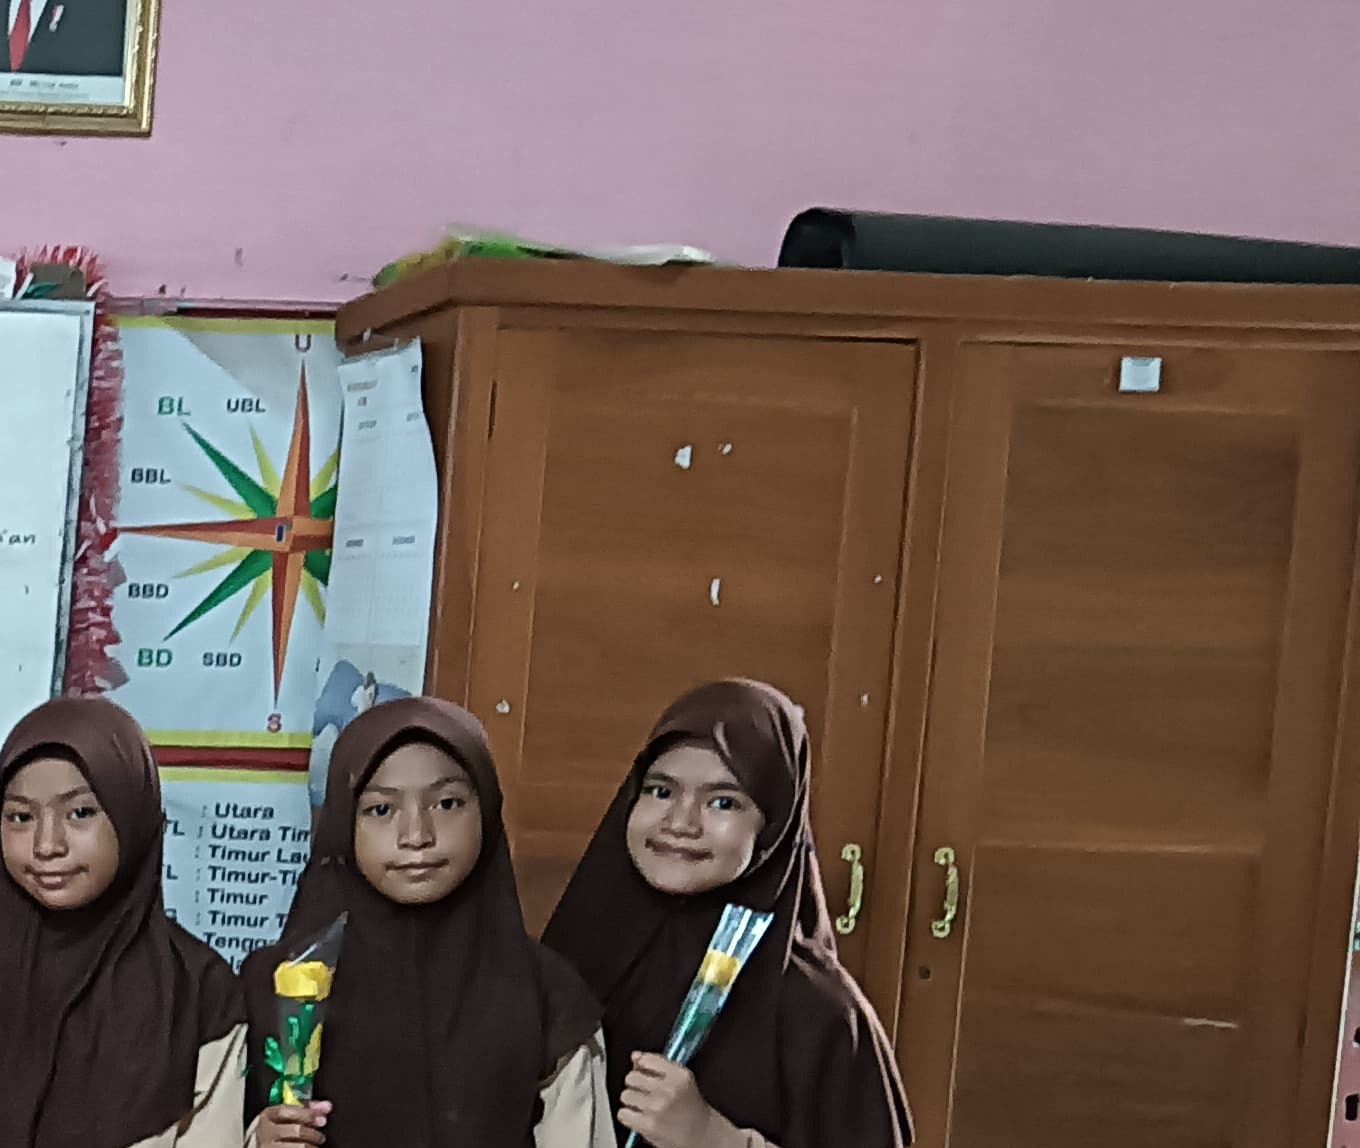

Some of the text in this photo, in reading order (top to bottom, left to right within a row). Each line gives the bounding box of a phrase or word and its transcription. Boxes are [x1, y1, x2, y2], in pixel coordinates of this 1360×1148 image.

[294, 333, 313, 353] U
[157, 396, 193, 418] BL
[226, 397, 267, 415] UBL
[130, 466, 172, 486] BBL
[127, 581, 170, 600] BBD
[136, 646, 174, 669] BD
[202, 650, 243, 669] SBD
[266, 713, 284, 734] S
[214, 802, 275, 820] Utara
[211, 823, 272, 842] Utara
[208, 844, 271, 863] Timur
[206, 887, 269, 906] Timur
[207, 910, 270, 928] Timur
